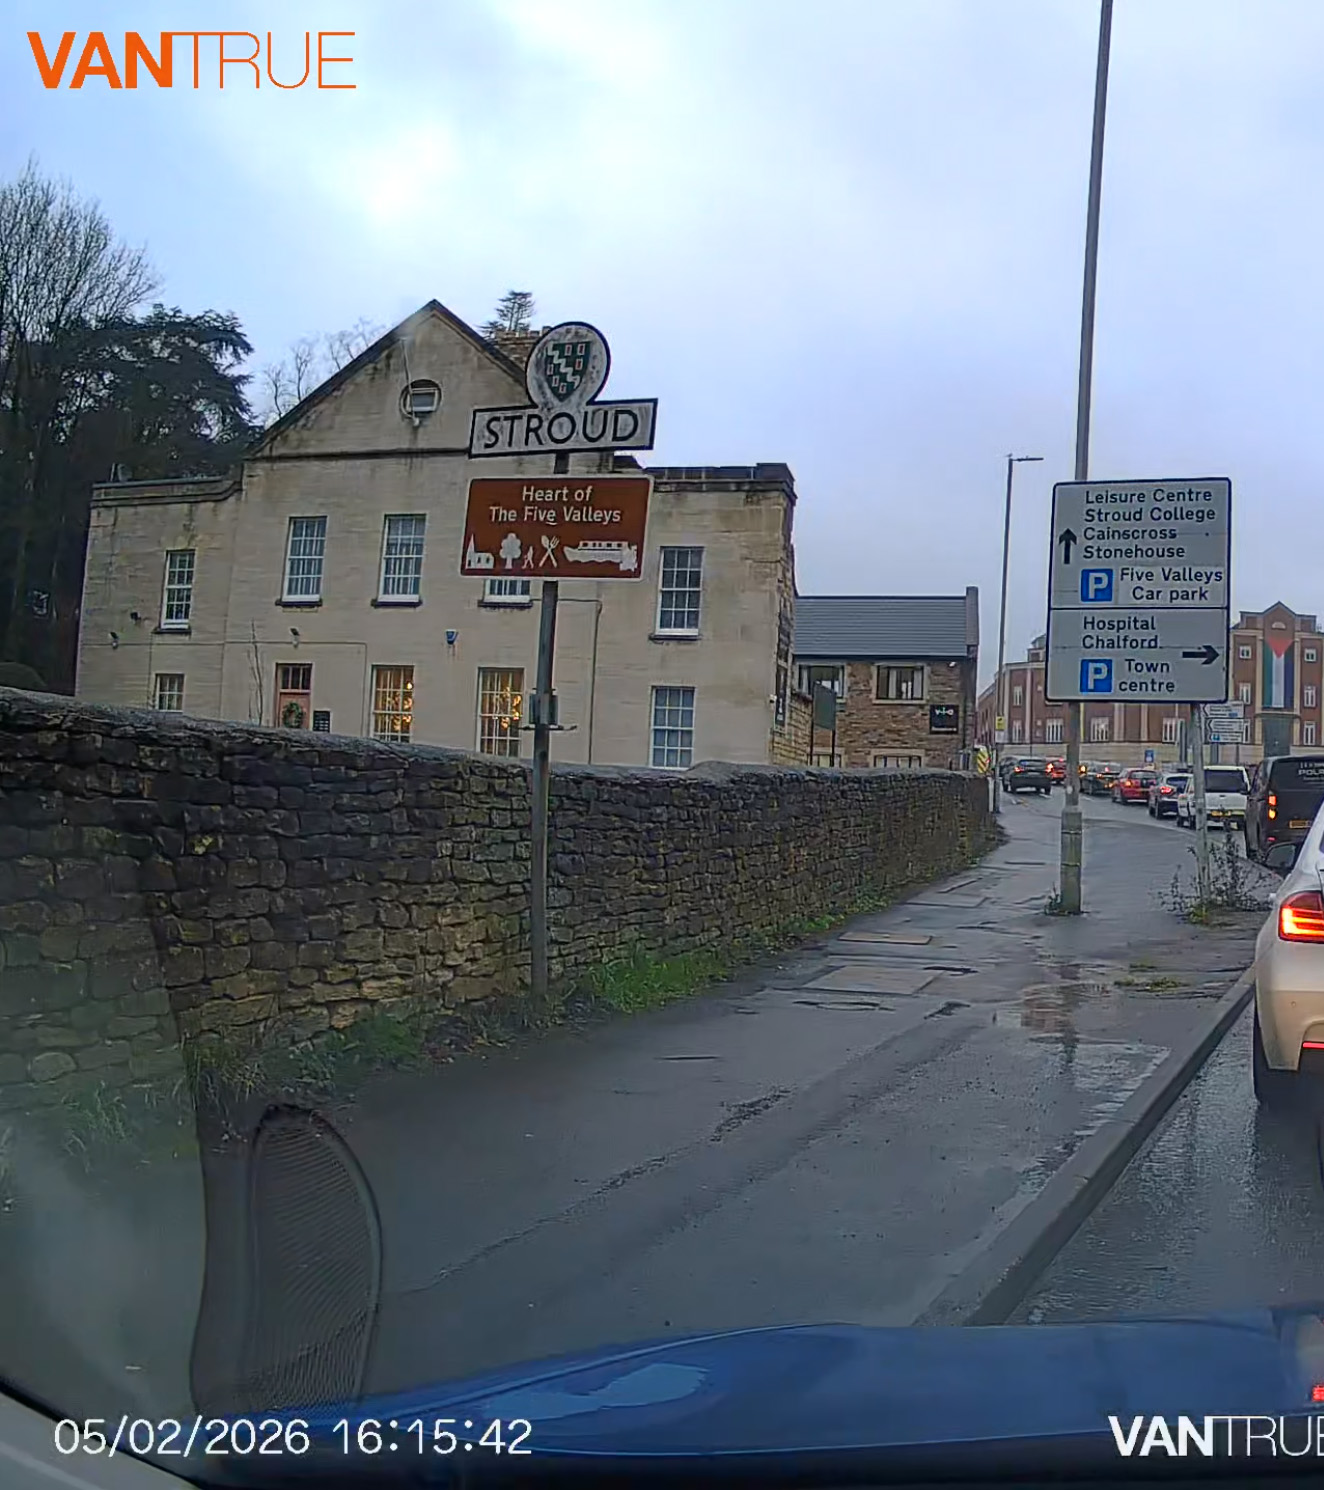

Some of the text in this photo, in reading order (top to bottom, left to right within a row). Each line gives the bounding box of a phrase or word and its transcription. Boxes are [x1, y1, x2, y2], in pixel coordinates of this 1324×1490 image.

[484, 409, 639, 449] STROUD
[522, 485, 593, 501] Heart of
[1085, 489, 1212, 505] Leisure Centre
[489, 506, 621, 525] The Five Valleys
[1084, 507, 1216, 523] Stroud College
[1083, 527, 1177, 541] Cainscross
[1083, 545, 1185, 560] Stonehouse
[1120, 568, 1223, 585] Five Valleys
[1088, 572, 1108, 599] P
[1132, 586, 1209, 603] Car park
[1083, 616, 1156, 633] Hospital
[1082, 635, 1159, 649] Chalford
[1125, 659, 1170, 674] Town
[1087, 662, 1108, 689] P
[1118, 678, 1175, 693] centre
